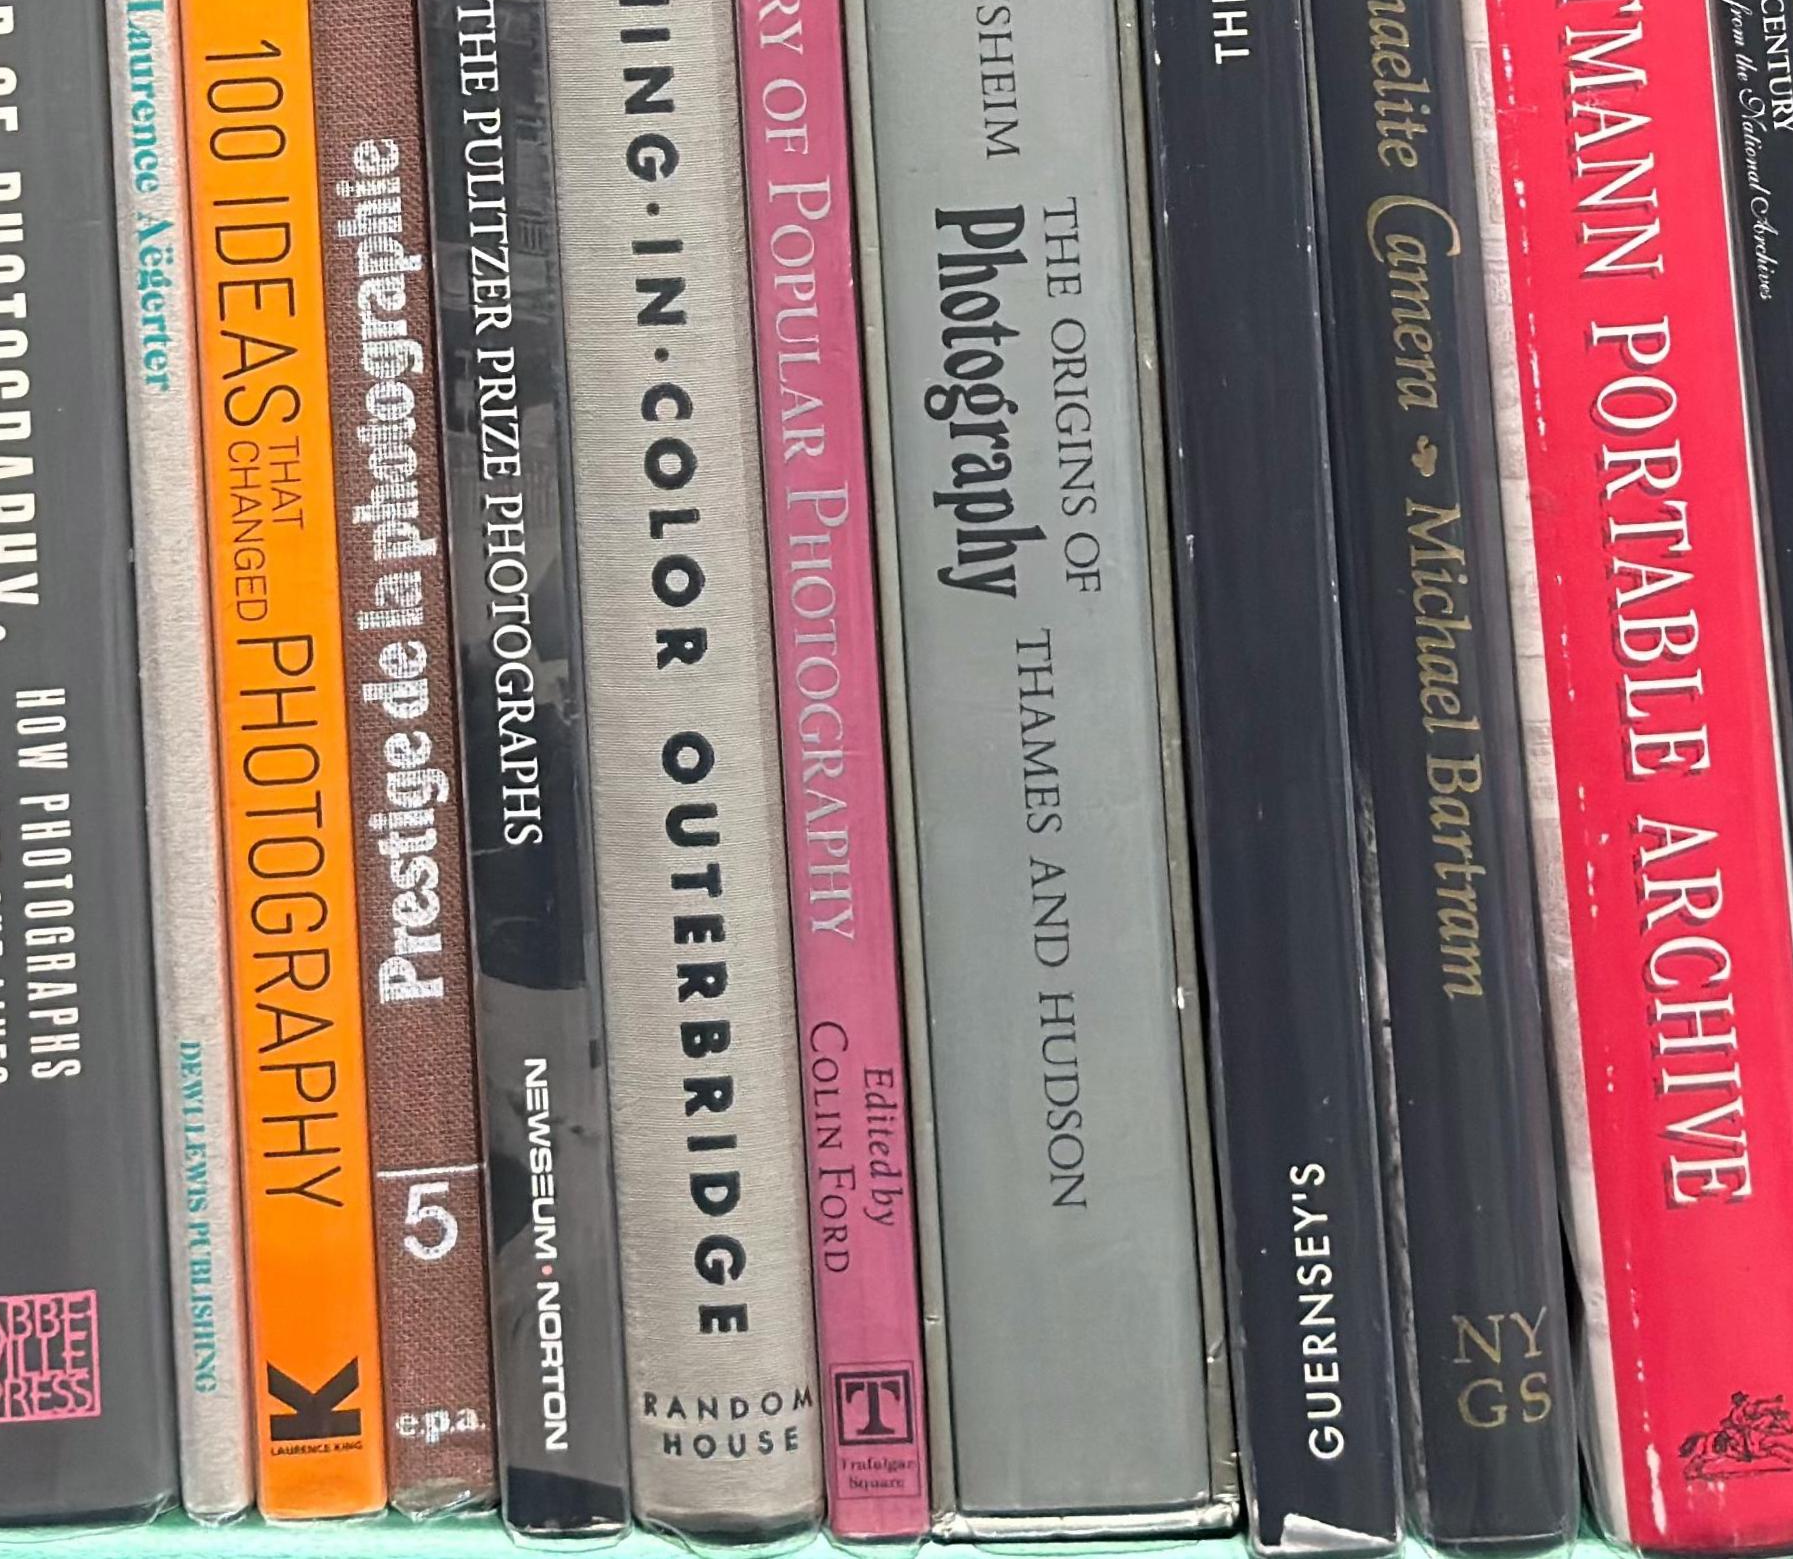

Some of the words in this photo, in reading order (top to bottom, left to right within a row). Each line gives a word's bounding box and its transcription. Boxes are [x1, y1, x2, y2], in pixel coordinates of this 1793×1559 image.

[204, 41, 286, 161] 100
[137, 209, 174, 394] Aëgerter
[212, 196, 301, 428] IDEAS
[460, 105, 512, 334] PULITZER
[1043, 196, 1082, 298] THE
[1367, 195, 1460, 411] Camera
[337, 139, 437, 562] photographie
[476, 346, 524, 480] PRIZE
[923, 204, 1048, 599] Photography
[1050, 318, 1098, 518] ORIGINS
[358, 574, 424, 631] la
[1064, 531, 1102, 596] OF
[1406, 498, 1474, 736] Michael
[1587, 315, 1712, 781] PORTABLE
[16, 689, 68, 769] HOW
[362, 641, 428, 720] de
[483, 491, 543, 846] PHOTOGRAPHS
[1016, 626, 1064, 835] THAMES
[21, 795, 80, 1080] PHOTOGRAPHS
[236, 634, 344, 1209] PHOTOGRAPHY
[371, 728, 450, 1004] Prestige
[1029, 856, 1070, 968] AND
[1425, 753, 1486, 999] Bartram
[178, 1039, 206, 1117] DEWI
[1039, 990, 1087, 1210] HUDSON
[1634, 813, 1754, 1208] ARCHIVE
[183, 1123, 209, 1214] LEWIS
[403, 1181, 458, 1261] 5
[524, 1058, 558, 1260] NEWSEUM
[188, 1219, 219, 1394] PUBLISHING
[536, 1282, 569, 1452] NORTON
[643, 1389, 814, 1422] RANDOM
[1290, 1162, 1344, 1459] GUERNSEY'S
[664, 1426, 799, 1458] HOUSE
